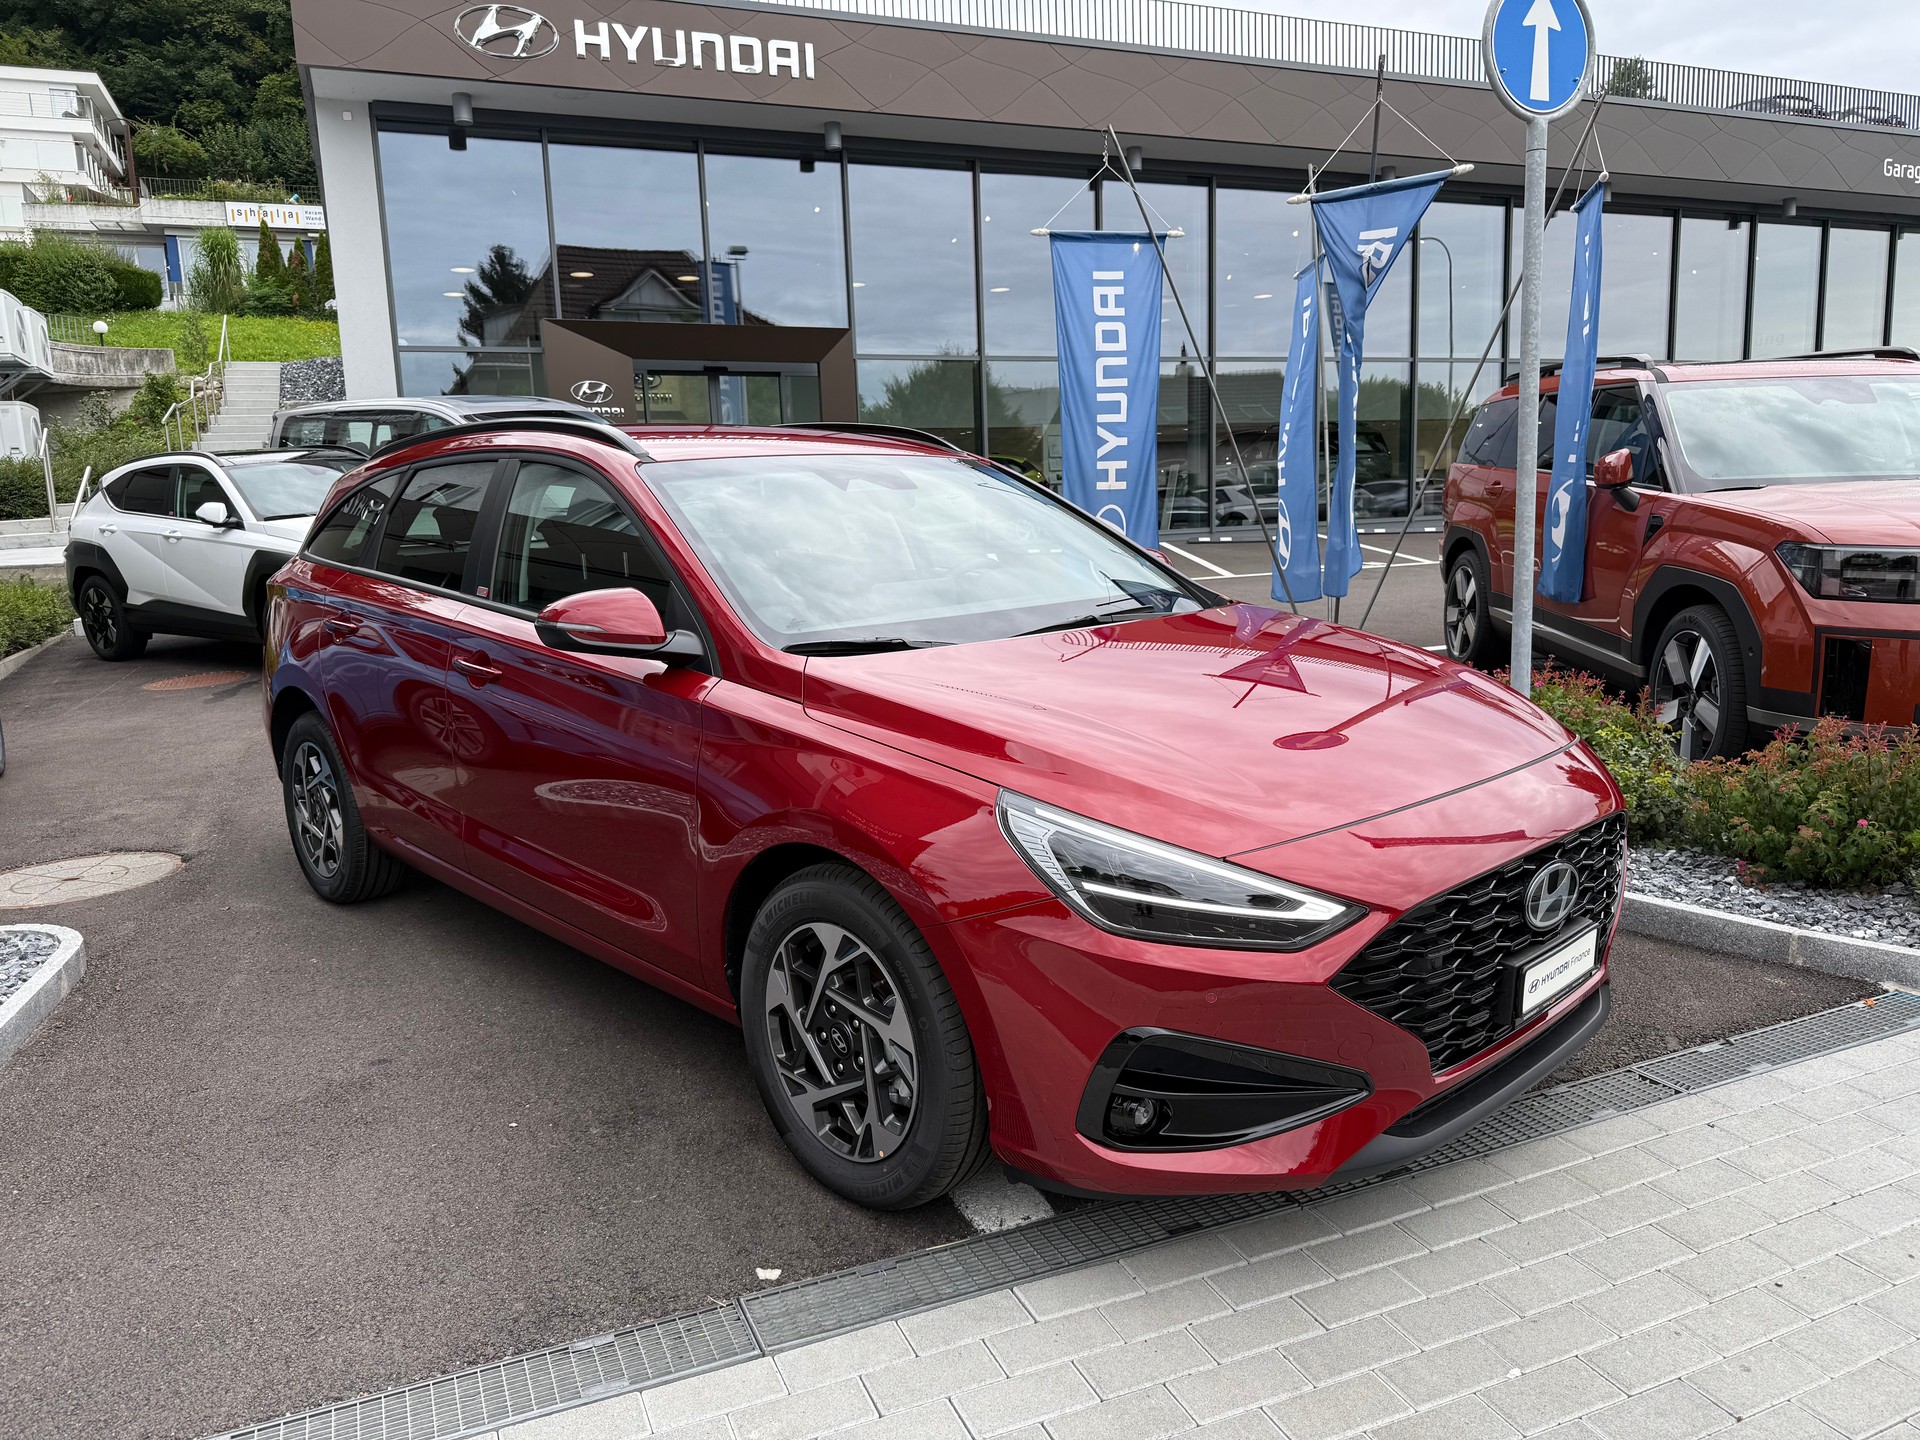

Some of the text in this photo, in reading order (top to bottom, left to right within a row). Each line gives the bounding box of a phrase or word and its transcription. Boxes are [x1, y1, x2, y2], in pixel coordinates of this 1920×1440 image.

[573, 19, 815, 80] HYUNDAI
[1092, 270, 1128, 491] HYUNDAI
[1540, 961, 1570, 986] HYUNDAI
[1570, 947, 1591, 968] Finance
